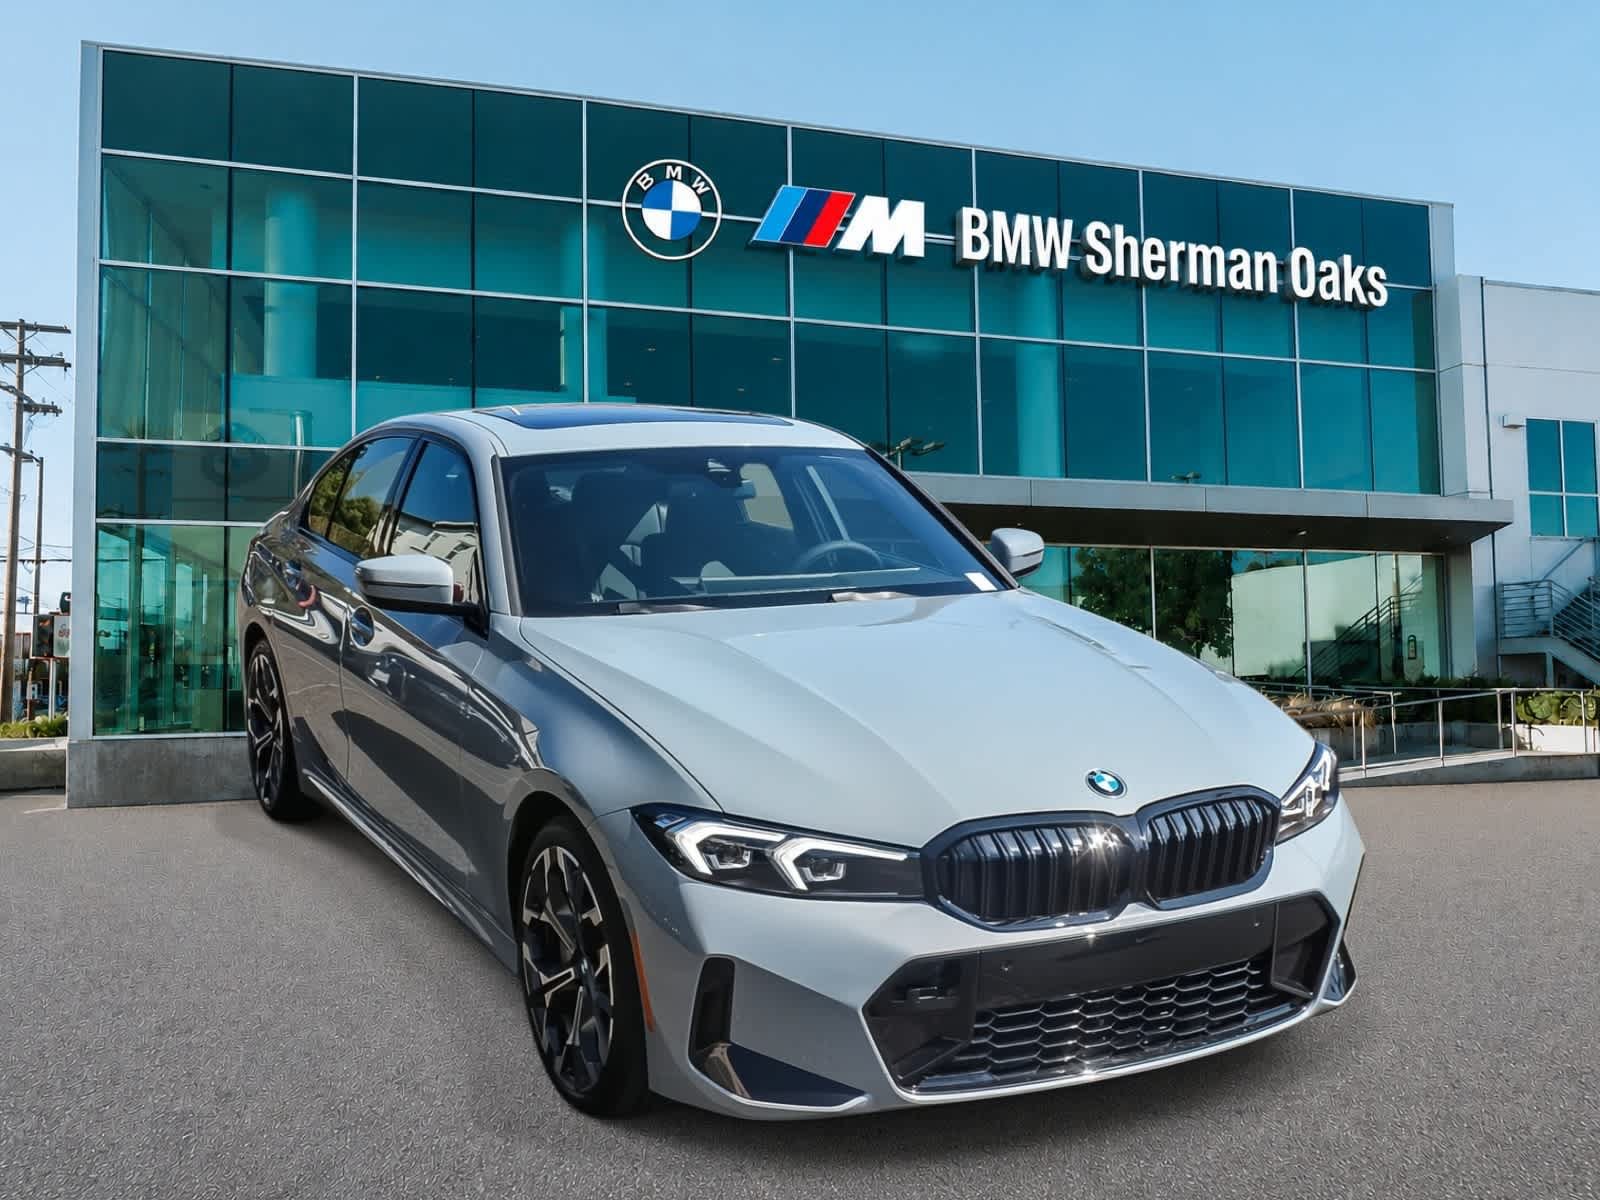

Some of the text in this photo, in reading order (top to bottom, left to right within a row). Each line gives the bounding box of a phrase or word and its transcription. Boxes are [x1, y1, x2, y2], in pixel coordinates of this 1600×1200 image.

[636, 165, 711, 191] BMW
[837, 195, 925, 257] M
[961, 206, 1389, 307] BMW Sherman Oaks
